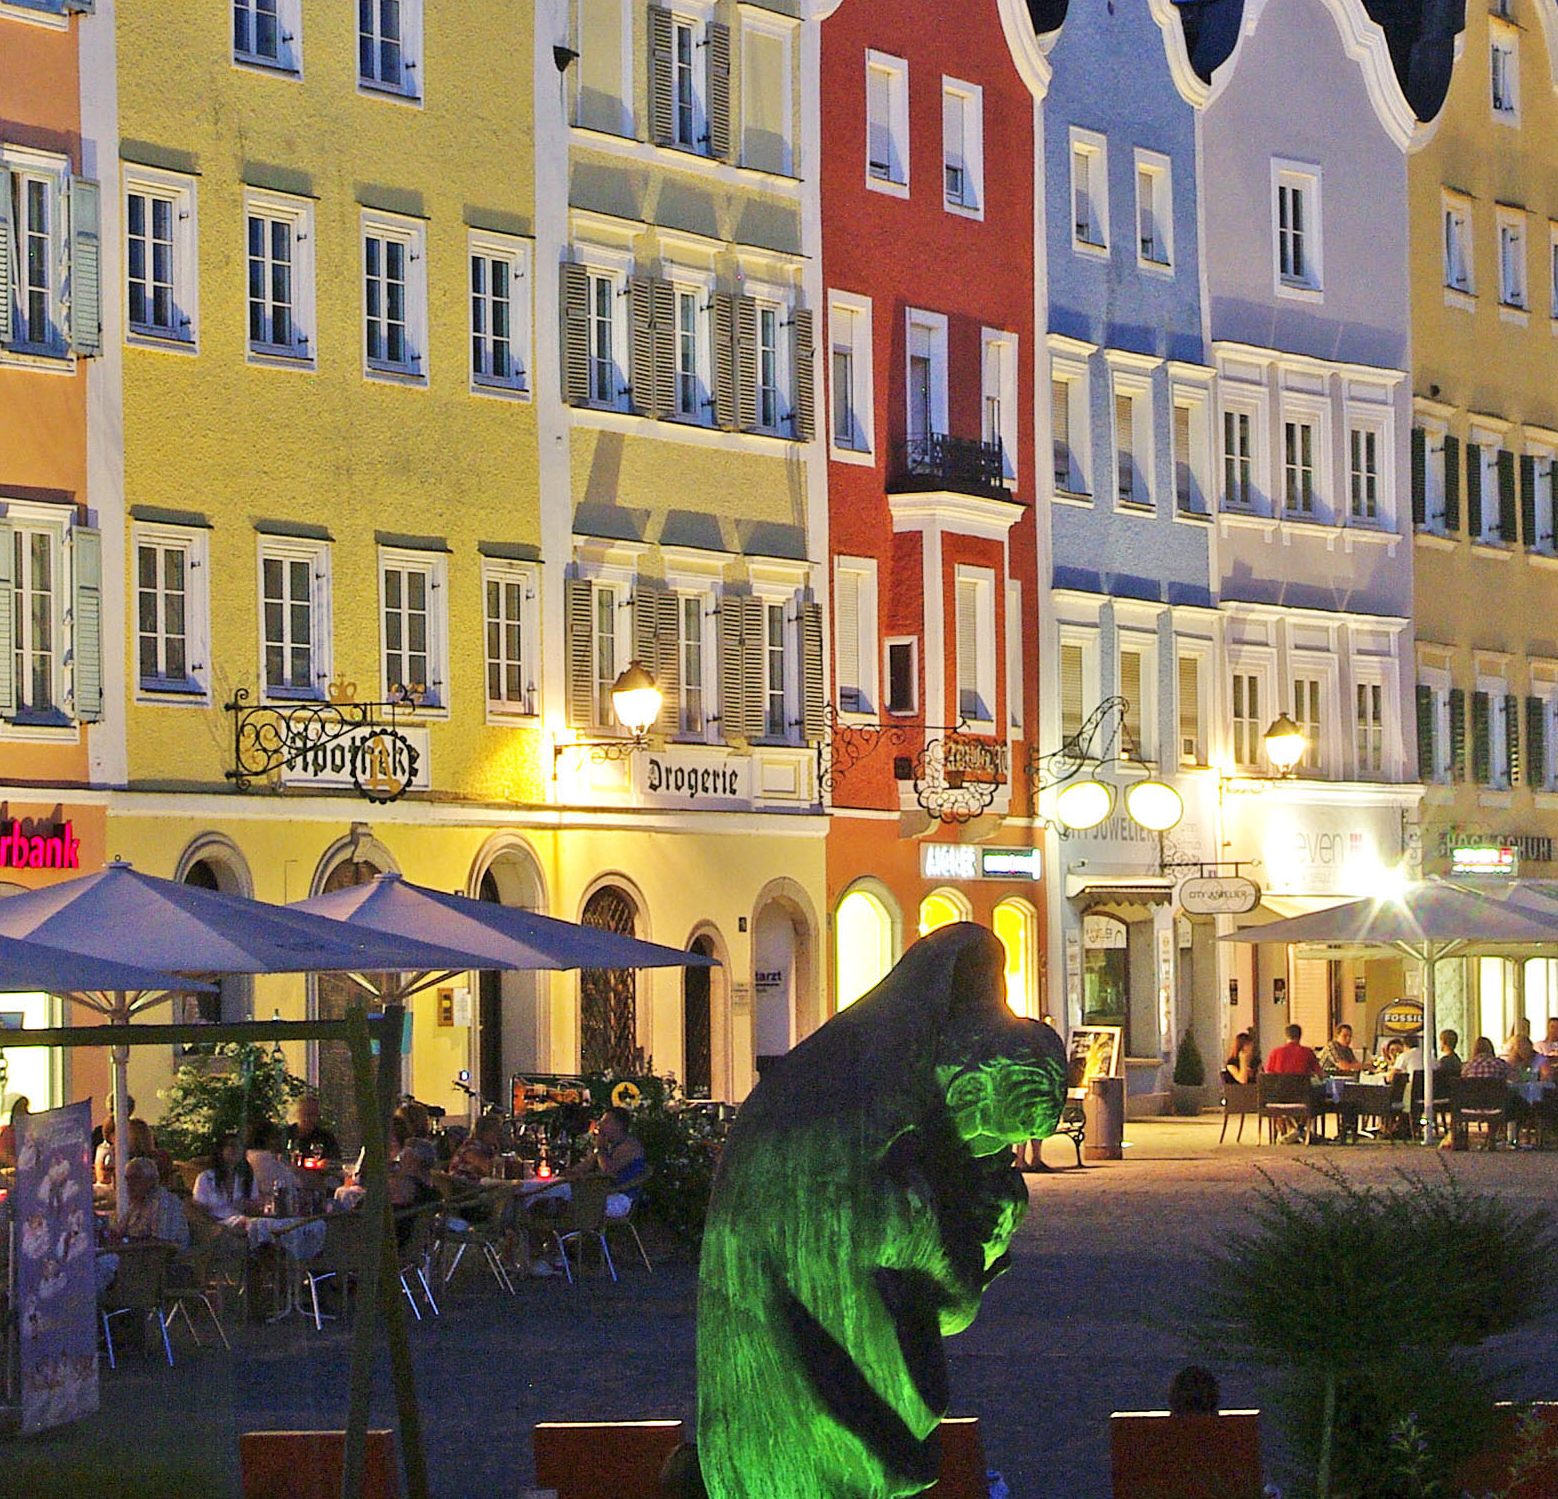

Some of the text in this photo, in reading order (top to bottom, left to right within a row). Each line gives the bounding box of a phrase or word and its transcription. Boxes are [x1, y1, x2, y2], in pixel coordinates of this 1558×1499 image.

[648, 759, 738, 798] Drogerie
[1293, 833, 1345, 864] even
[1384, 1013, 1423, 1022] FOSSIL
